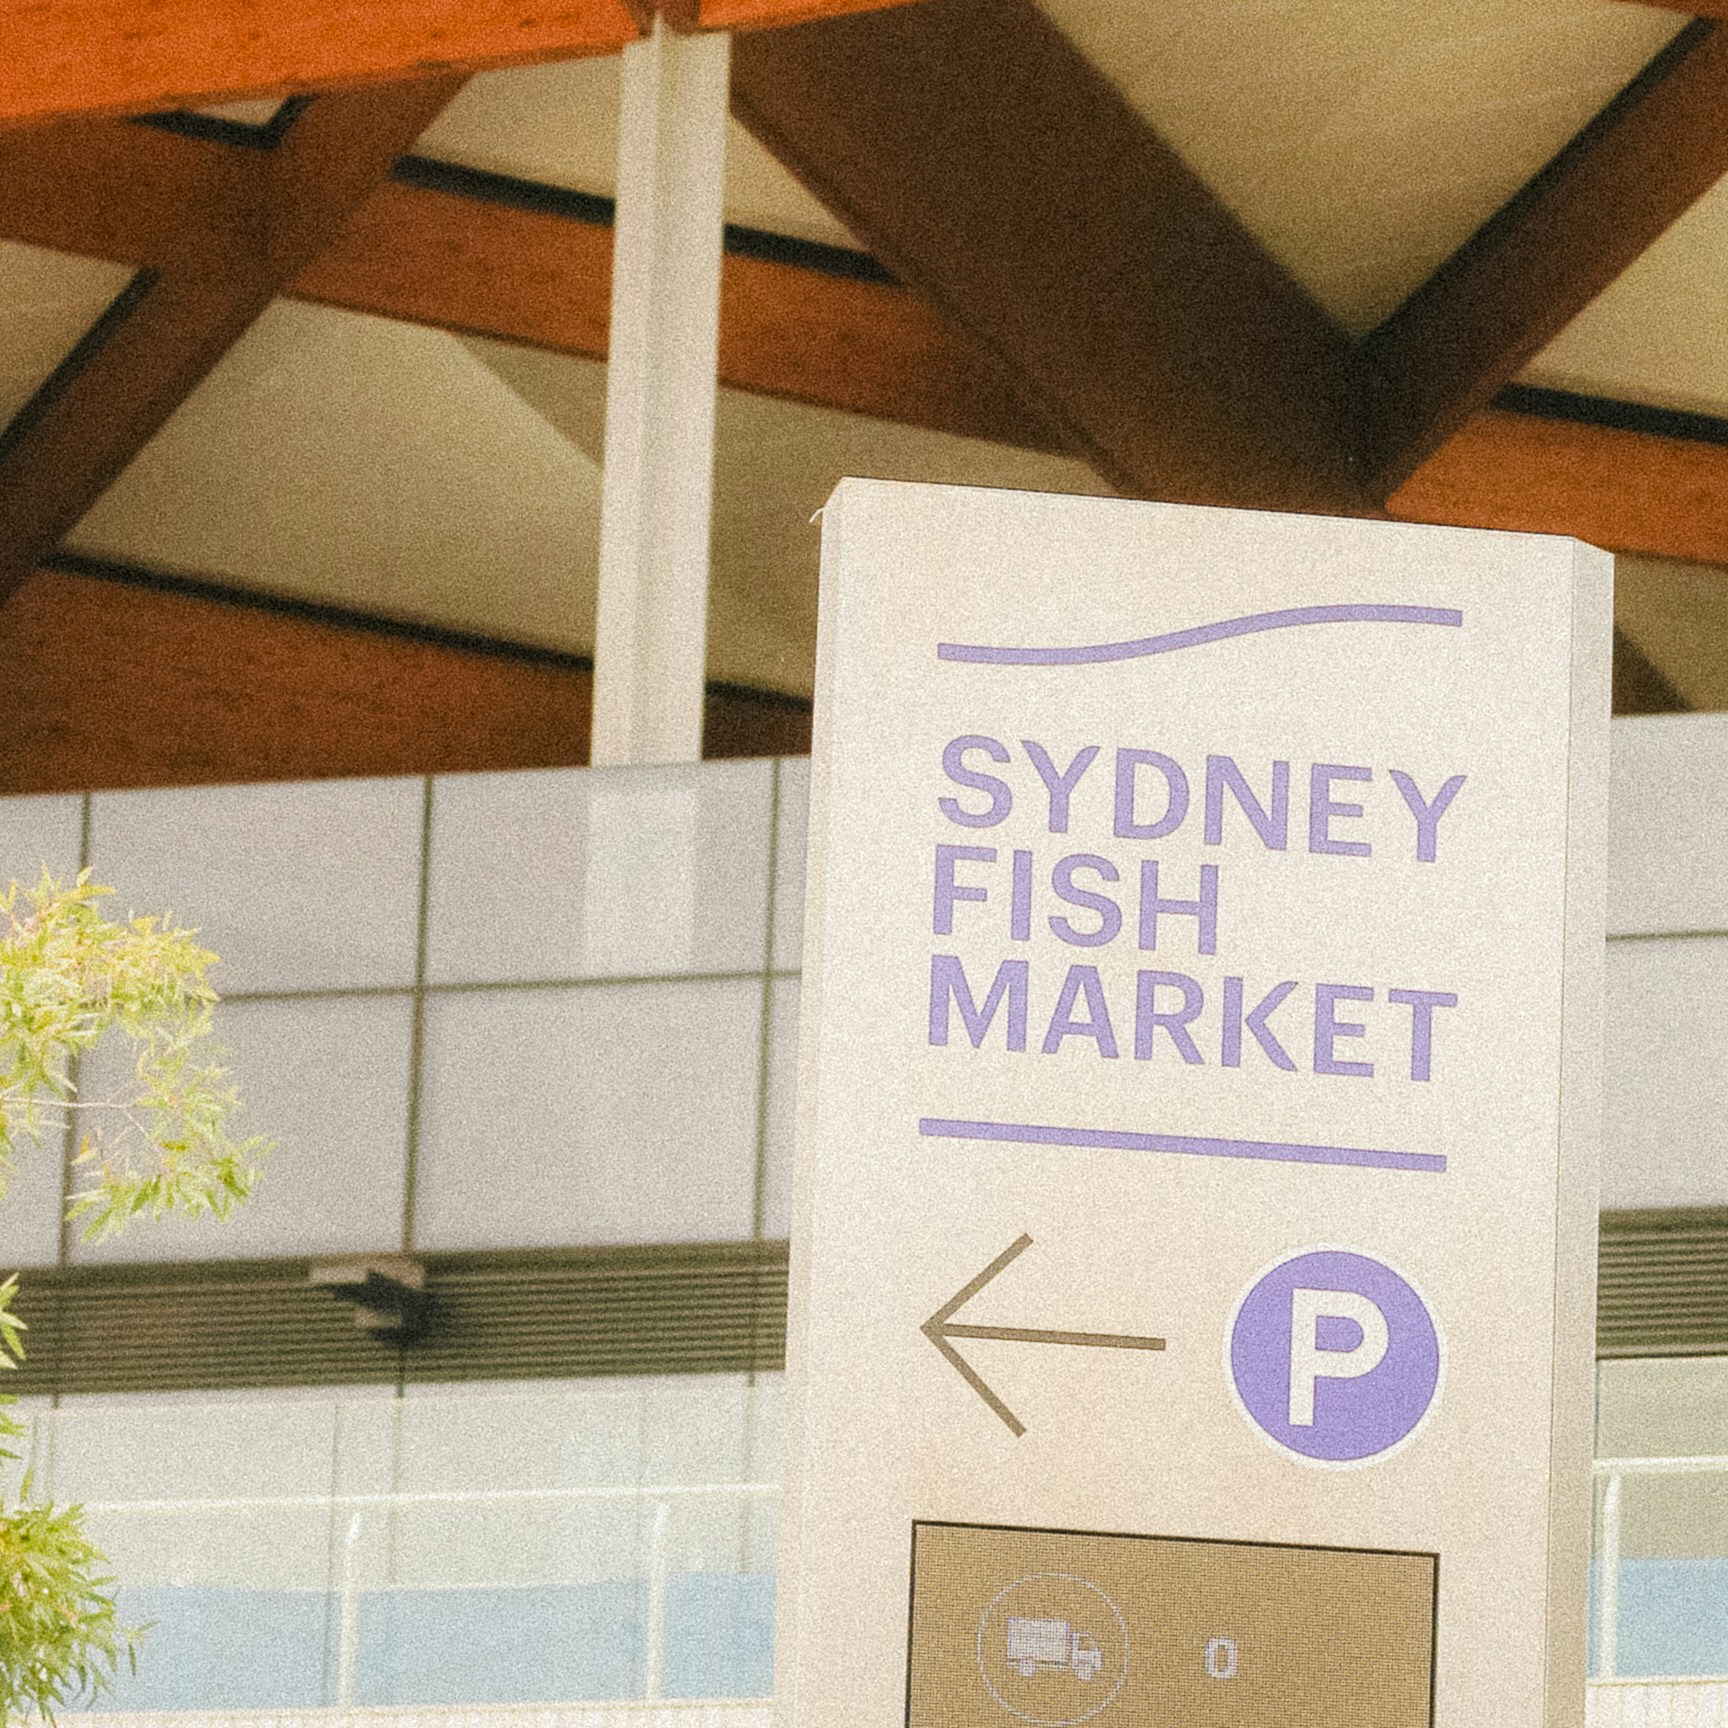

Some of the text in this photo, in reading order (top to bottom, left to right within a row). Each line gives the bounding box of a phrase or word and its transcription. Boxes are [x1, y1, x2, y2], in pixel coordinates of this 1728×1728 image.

[938, 734, 1467, 863] SYDNEY
[932, 843, 1219, 955] FISH
[928, 953, 1459, 1083] MARKET
[1288, 1287, 1390, 1427] P
[1205, 1637, 1238, 1679] 0
